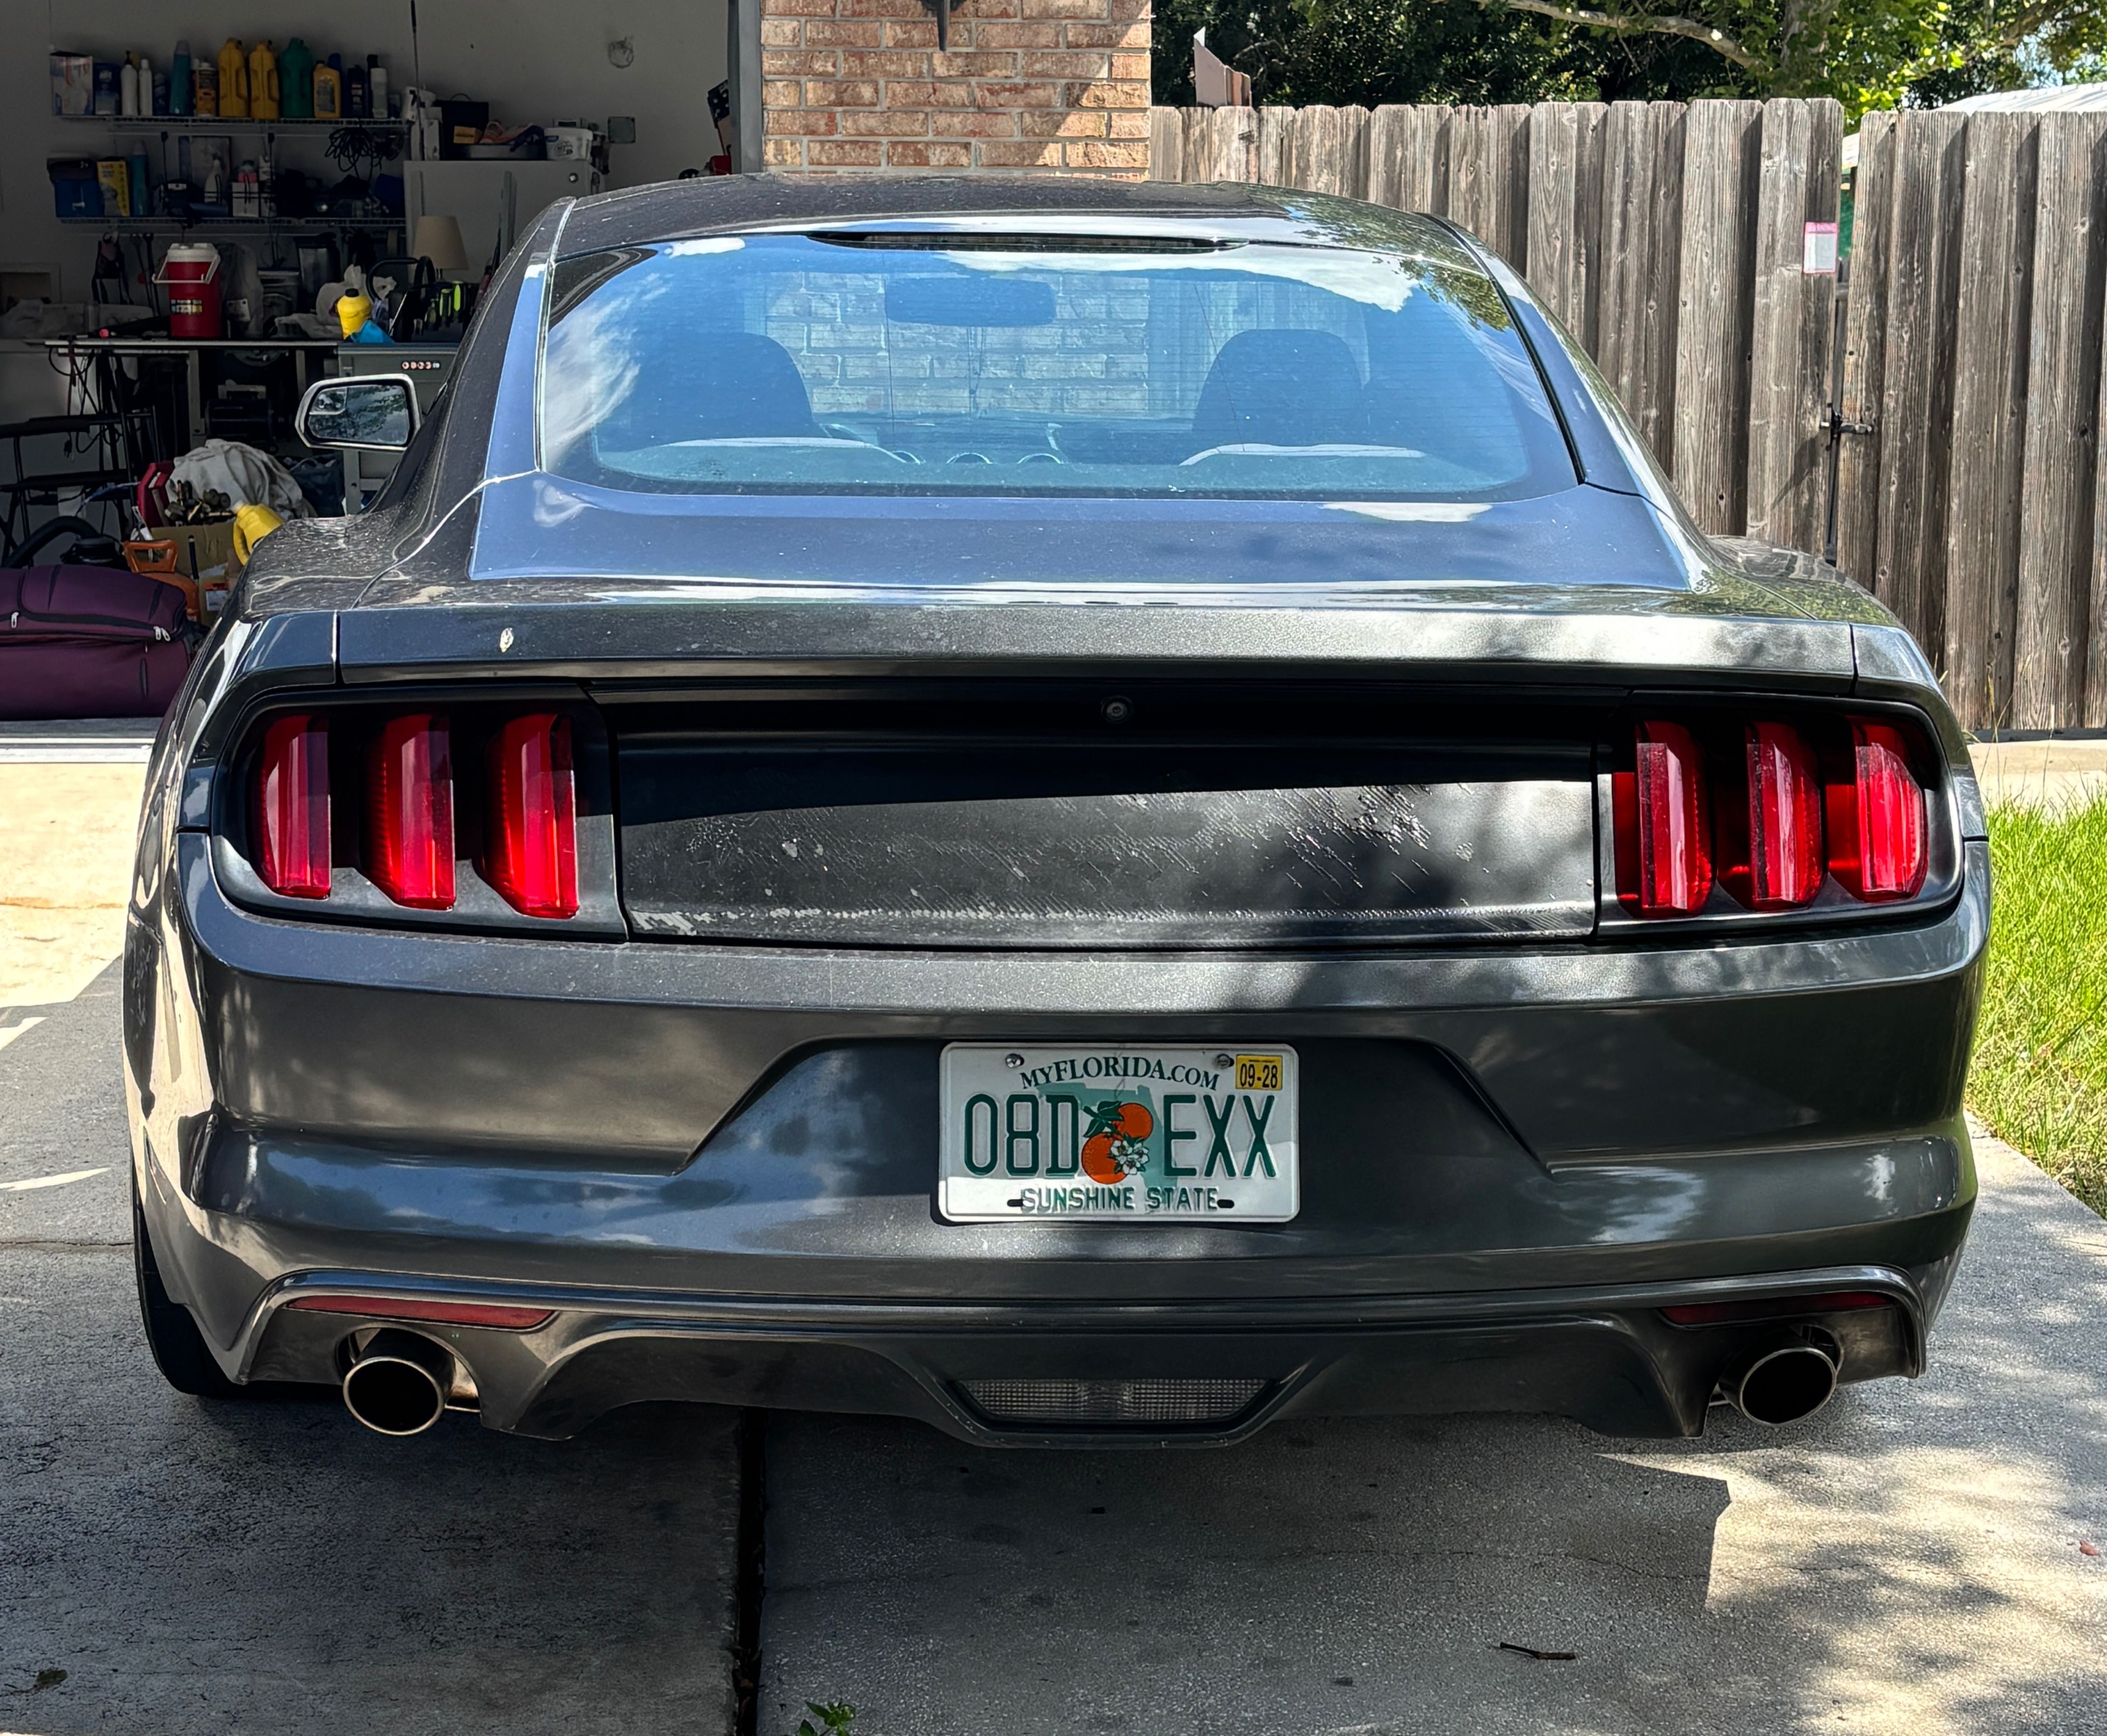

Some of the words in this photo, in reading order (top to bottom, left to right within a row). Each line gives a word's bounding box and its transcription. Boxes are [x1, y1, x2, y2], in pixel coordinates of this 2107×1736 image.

[1019, 1056, 1220, 1091] MYFLORIDA.COM
[964, 1093, 1079, 1177] 08D
[1163, 1094, 1276, 1178] EXX
[1022, 1187, 1135, 1211] SUNSHINE
[1146, 1187, 1219, 1211] STATE
